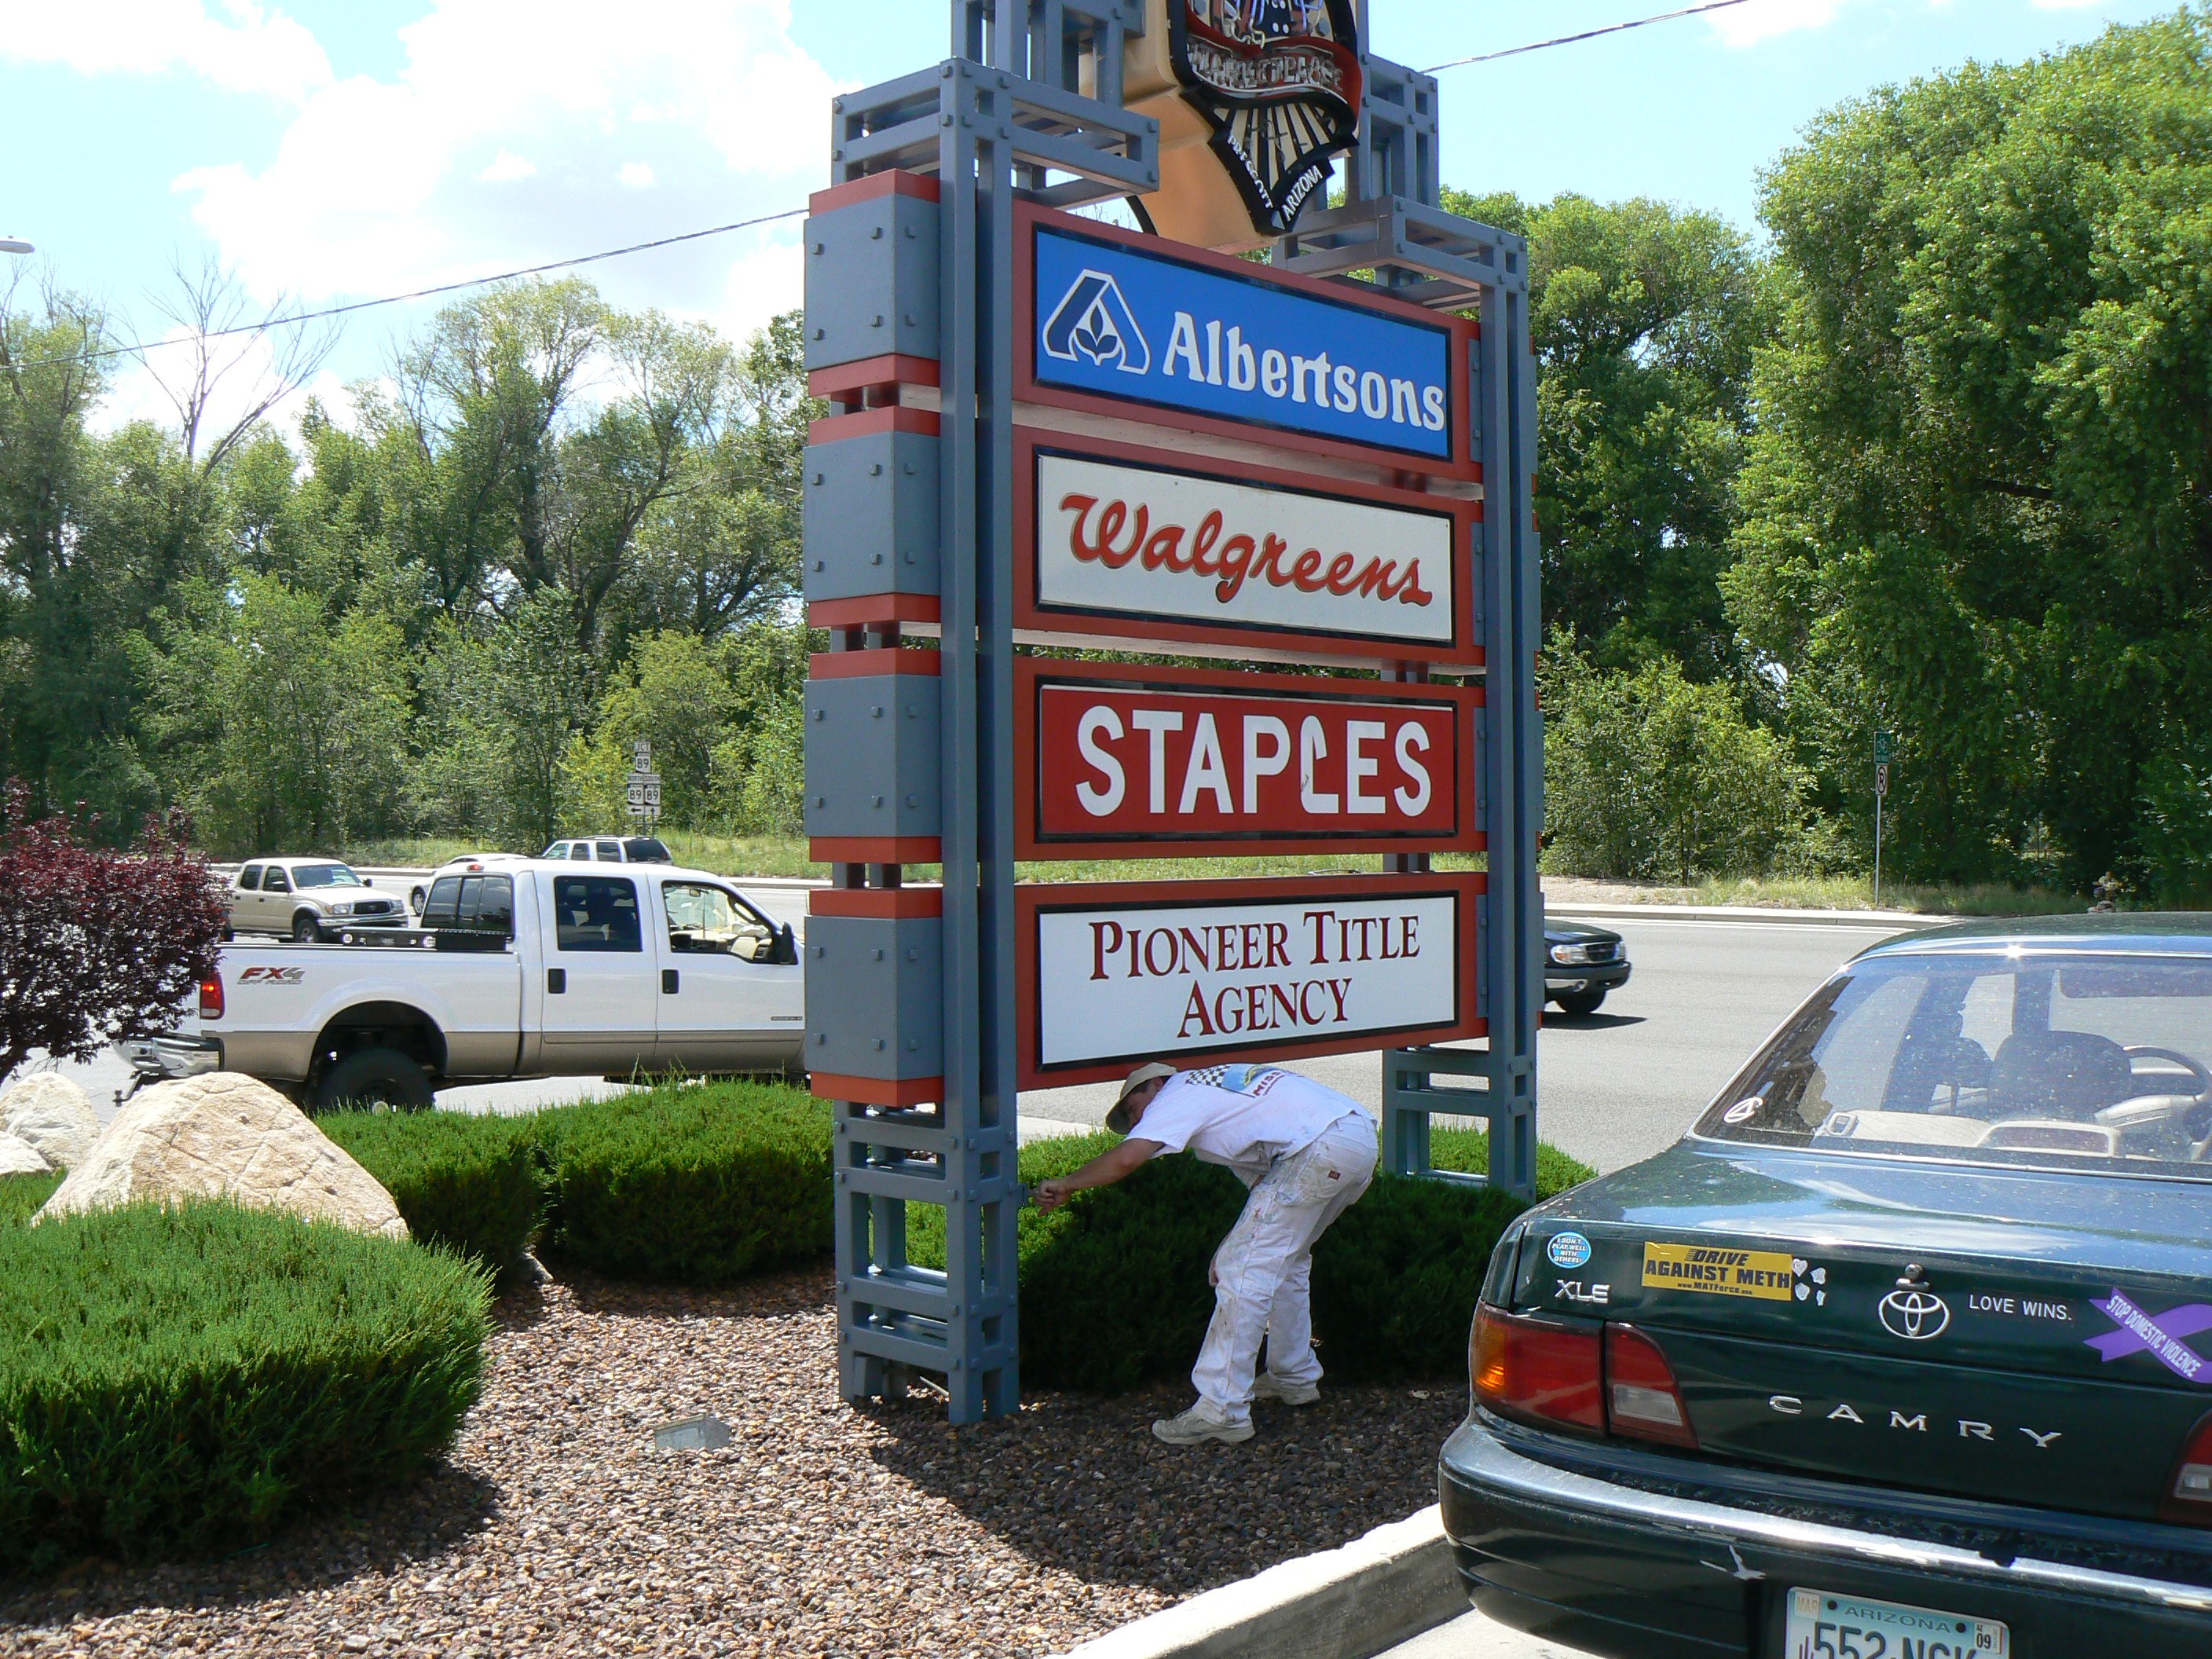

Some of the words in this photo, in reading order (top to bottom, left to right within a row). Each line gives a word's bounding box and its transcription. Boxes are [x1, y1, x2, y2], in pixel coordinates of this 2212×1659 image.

[1227, 134, 1273, 209] PRESCOTT
[1281, 164, 1323, 222] ARIZONA
[1163, 311, 1445, 431] Albertsons
[1059, 492, 1433, 606] Walgreens
[636, 742, 650, 751] JCT
[637, 758, 649, 768] 89
[1075, 705, 1432, 818] STAPLES
[629, 789, 642, 800] 89
[646, 790, 659, 800] 89
[1089, 920, 1292, 981] PIONEER
[1302, 910, 1421, 965] TITLE
[240, 967, 306, 980] FX4
[1177, 977, 1353, 1039] AGENCY
[1684, 1249, 1749, 1266] DRIVE
[1644, 1259, 1728, 1282] AGAINST
[1736, 1268, 1791, 1288] METH
[1555, 1279, 1610, 1304] XLE
[1969, 1294, 2015, 1313] LOVE
[2022, 1300, 2072, 1320] WINS.
[2106, 1295, 2132, 1319] STOP
[2123, 1309, 2166, 1350] DOMESTIC
[2159, 1338, 2202, 1378] VIOLENCE
[1768, 1395, 2062, 1448] CAMRY
[1844, 1606, 1951, 1634] ARIZONA
[1814, 1621, 1887, 1659] 552
[1976, 1632, 1991, 1650] 09
